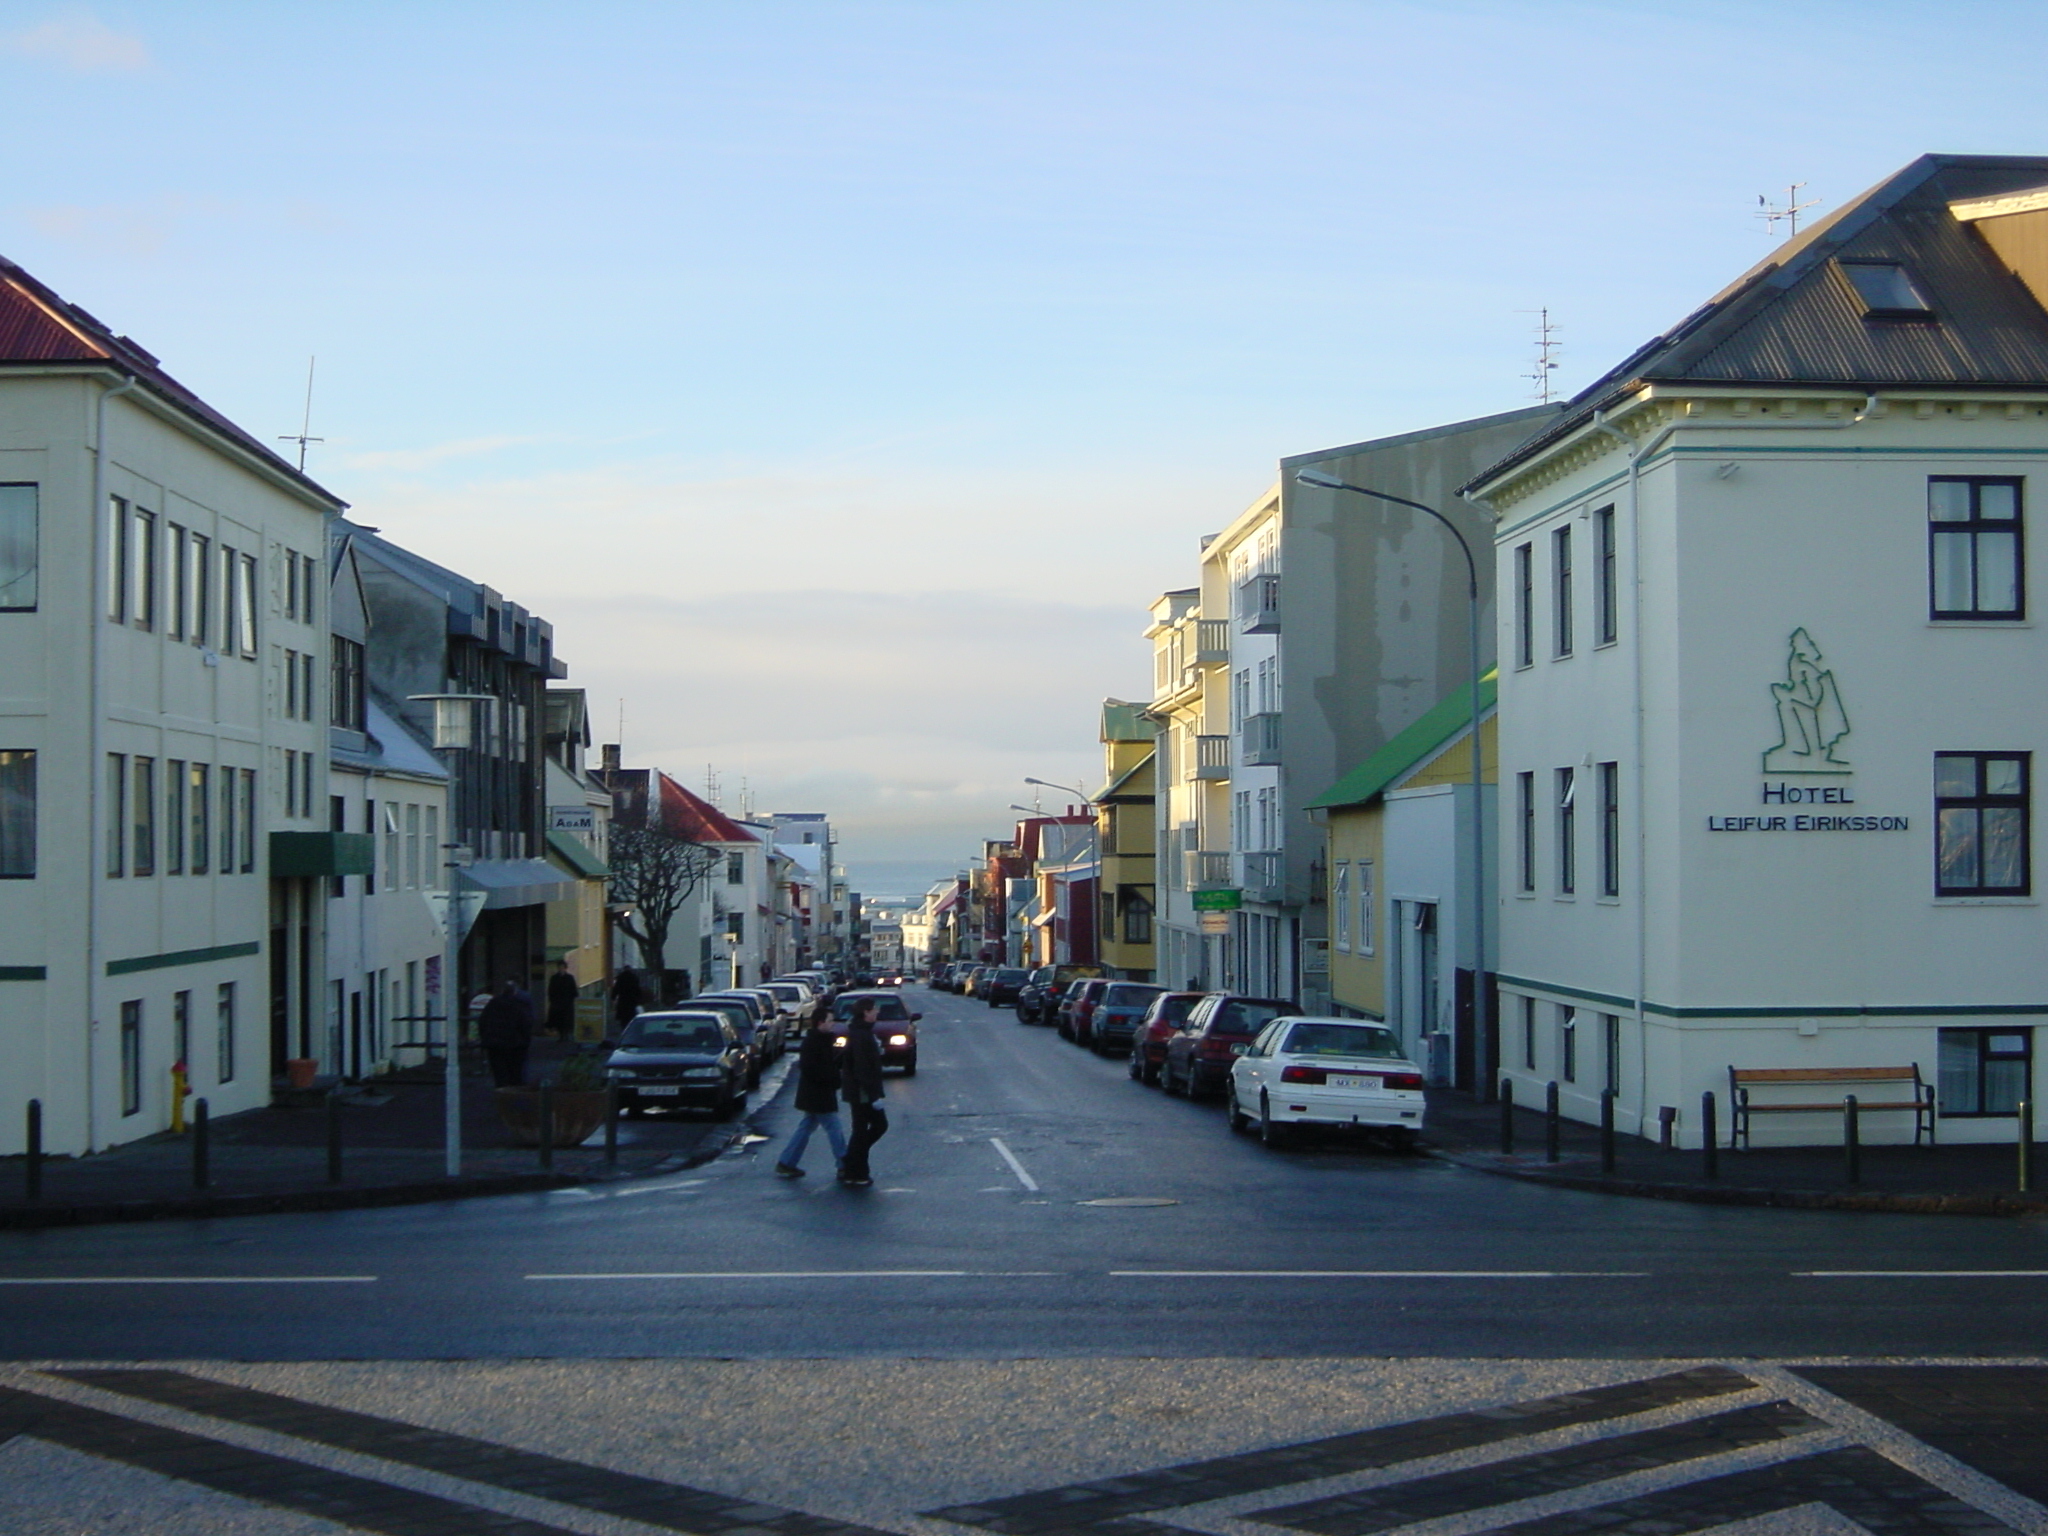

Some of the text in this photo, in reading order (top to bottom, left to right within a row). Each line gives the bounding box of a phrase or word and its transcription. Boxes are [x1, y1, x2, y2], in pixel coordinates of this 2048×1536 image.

[1763, 782, 1854, 804] HOTEL
[1709, 815, 1909, 831] LEIFUR EIRIKSSON
